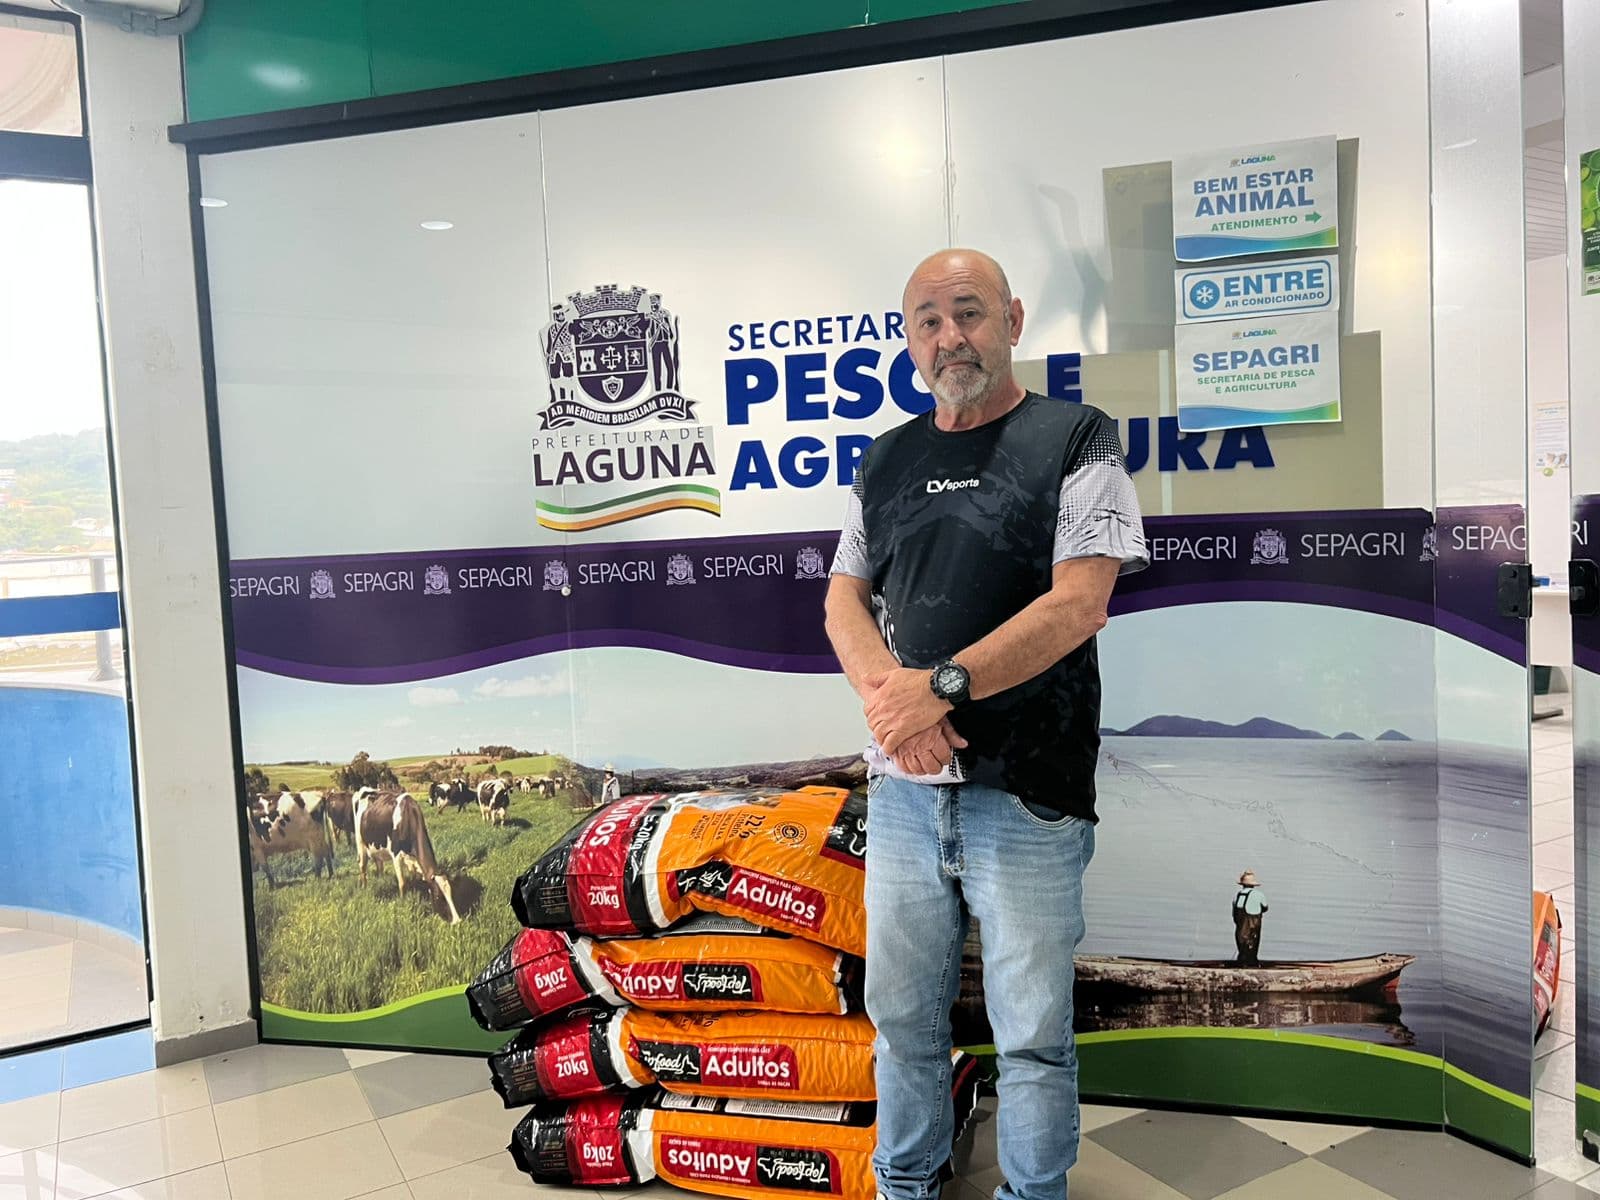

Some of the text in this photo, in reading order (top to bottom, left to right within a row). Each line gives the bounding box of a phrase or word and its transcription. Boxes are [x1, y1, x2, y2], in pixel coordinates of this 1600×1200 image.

[1194, 168, 1314, 195] BEM ESTAR
[1195, 186, 1314, 218] ANIMAL
[1211, 215, 1298, 232] ATENDIMENTO
[1223, 268, 1325, 298] ENTRE
[1225, 291, 1325, 308] AR CONDICIONADO
[1193, 343, 1320, 373] SEPAGRI
[1047, 353, 1083, 404] E
[1197, 369, 1316, 386] SECRETARIA DE PESCA
[1215, 381, 1297, 394] E AGRICULTURA
[550, 396, 683, 425] AD MERIDIEM BRASILIAM DVXI
[532, 426, 704, 450] PREFEITURA DE
[533, 442, 716, 487] LAGUNA
[1300, 531, 1405, 558] SEPAGRI
[458, 566, 533, 588] SEPAGRI
[578, 560, 655, 585] SEPAGRI
[703, 553, 784, 578] SEPAGRI
[229, 576, 300, 598] SEPAGRI
[344, 571, 415, 593] SEPAGRI
[587, 891, 620, 909] 20kg
[732, 876, 817, 920] Adultos
[535, 967, 568, 989] 20kg
[699, 974, 752, 994] Topfood
[554, 1058, 589, 1078] 20kg
[705, 1055, 790, 1078] Adultos
[583, 1142, 615, 1163] 20kg
[668, 1149, 829, 1184] Topfood Adultos
